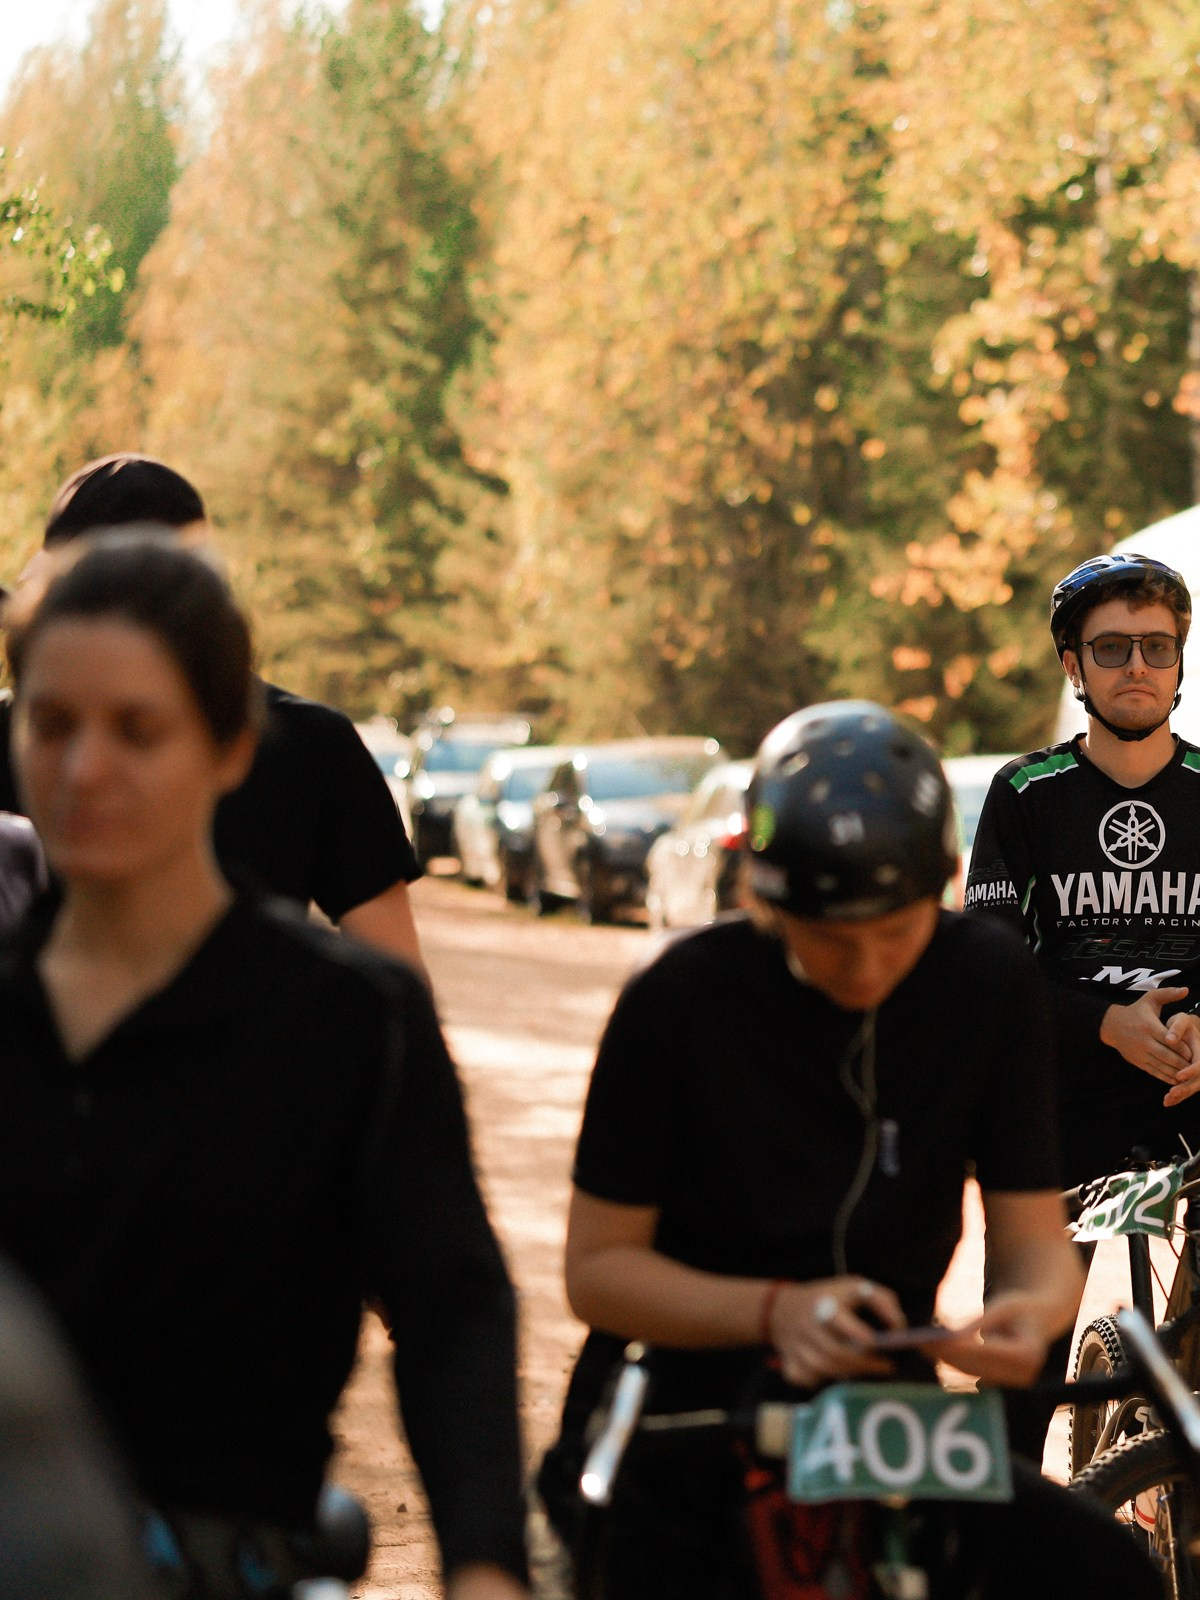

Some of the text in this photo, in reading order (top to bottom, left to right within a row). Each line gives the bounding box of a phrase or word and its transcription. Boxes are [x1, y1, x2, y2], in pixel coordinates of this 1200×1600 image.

[1056, 918, 1132, 928] FACTORY
[1085, 1177, 1171, 1229] 02
[801, 1398, 992, 1490] 406
